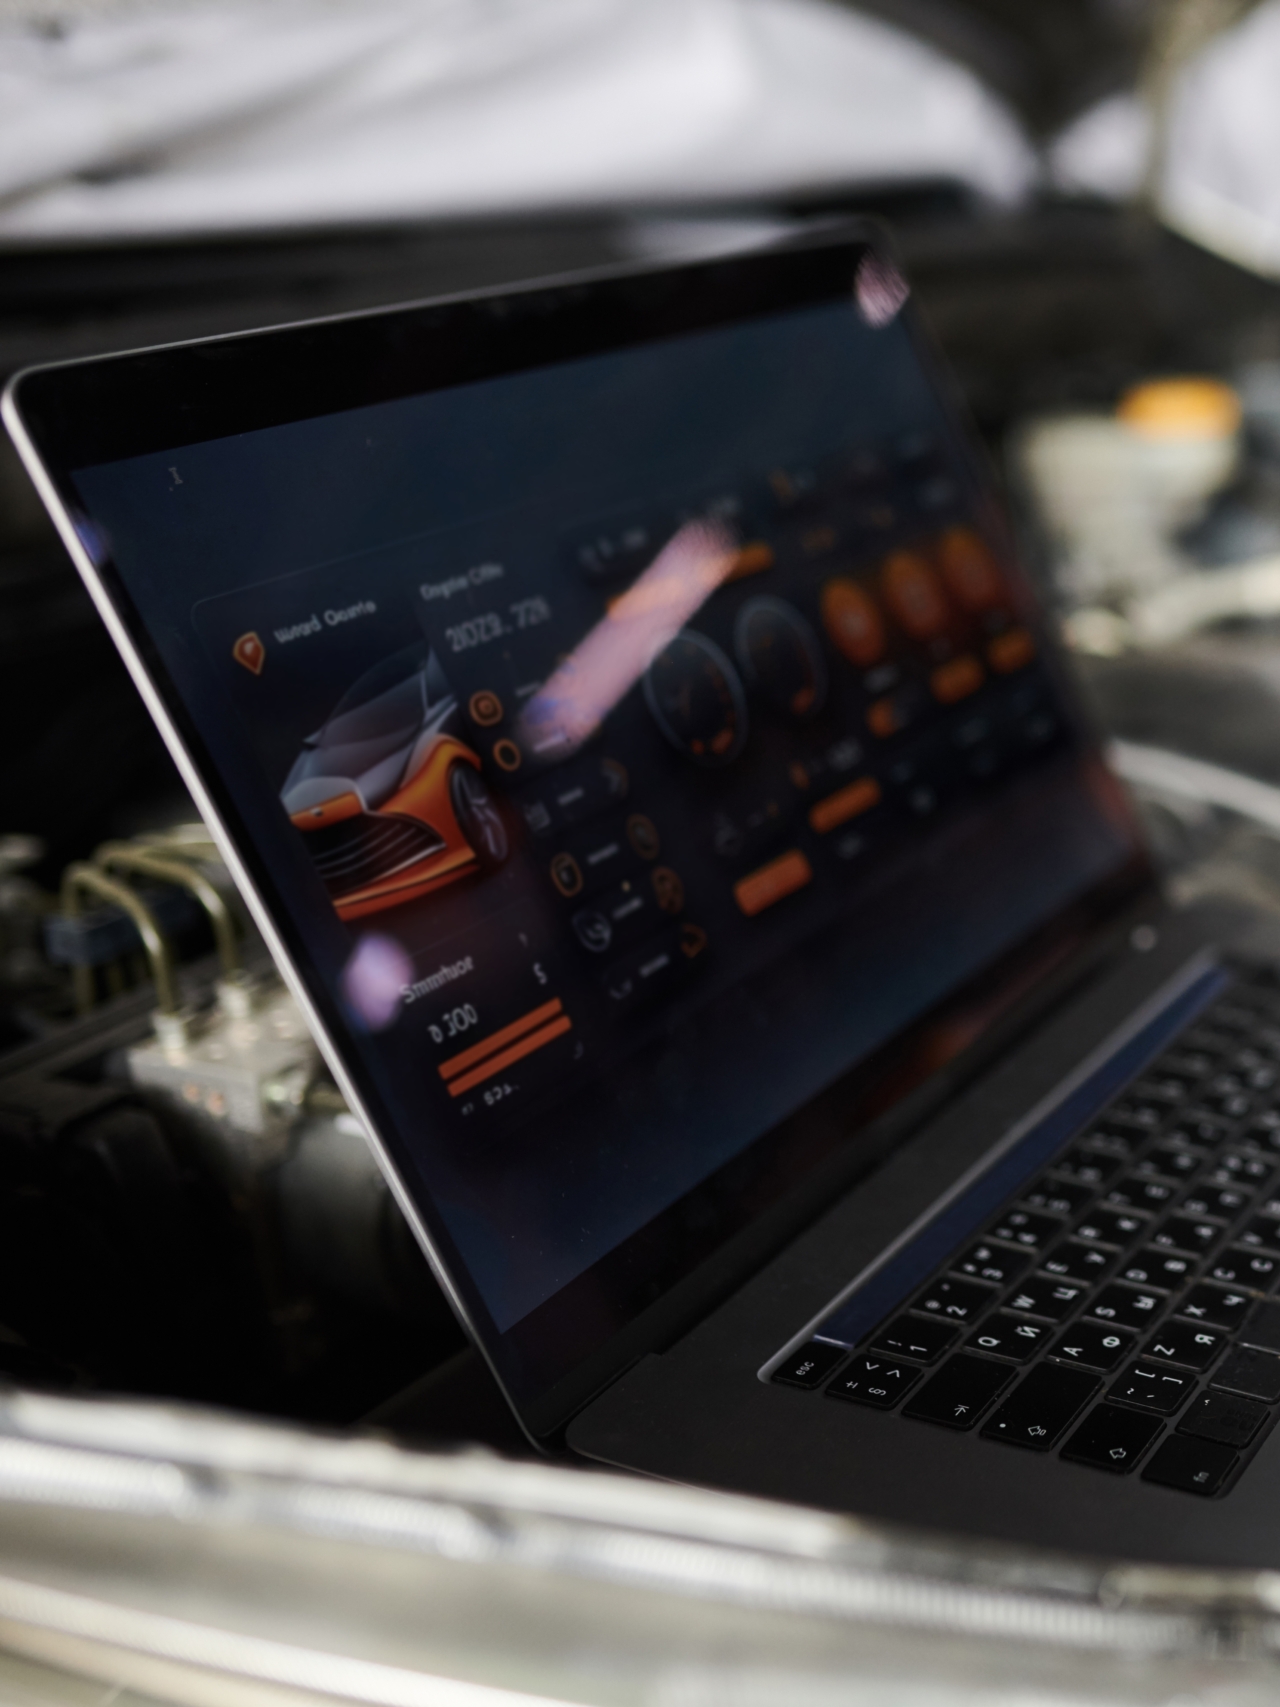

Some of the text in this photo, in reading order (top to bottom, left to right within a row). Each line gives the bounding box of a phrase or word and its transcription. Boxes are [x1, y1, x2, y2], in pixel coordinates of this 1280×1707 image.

[946, 1305, 968, 1316] 2
[977, 1336, 1001, 1347] Q
[1102, 1336, 1121, 1348] Ф
[1194, 1333, 1216, 1346] Я
[1062, 1346, 1084, 1357] A
[1153, 1344, 1176, 1356] Z
[795, 1360, 815, 1376] esc
